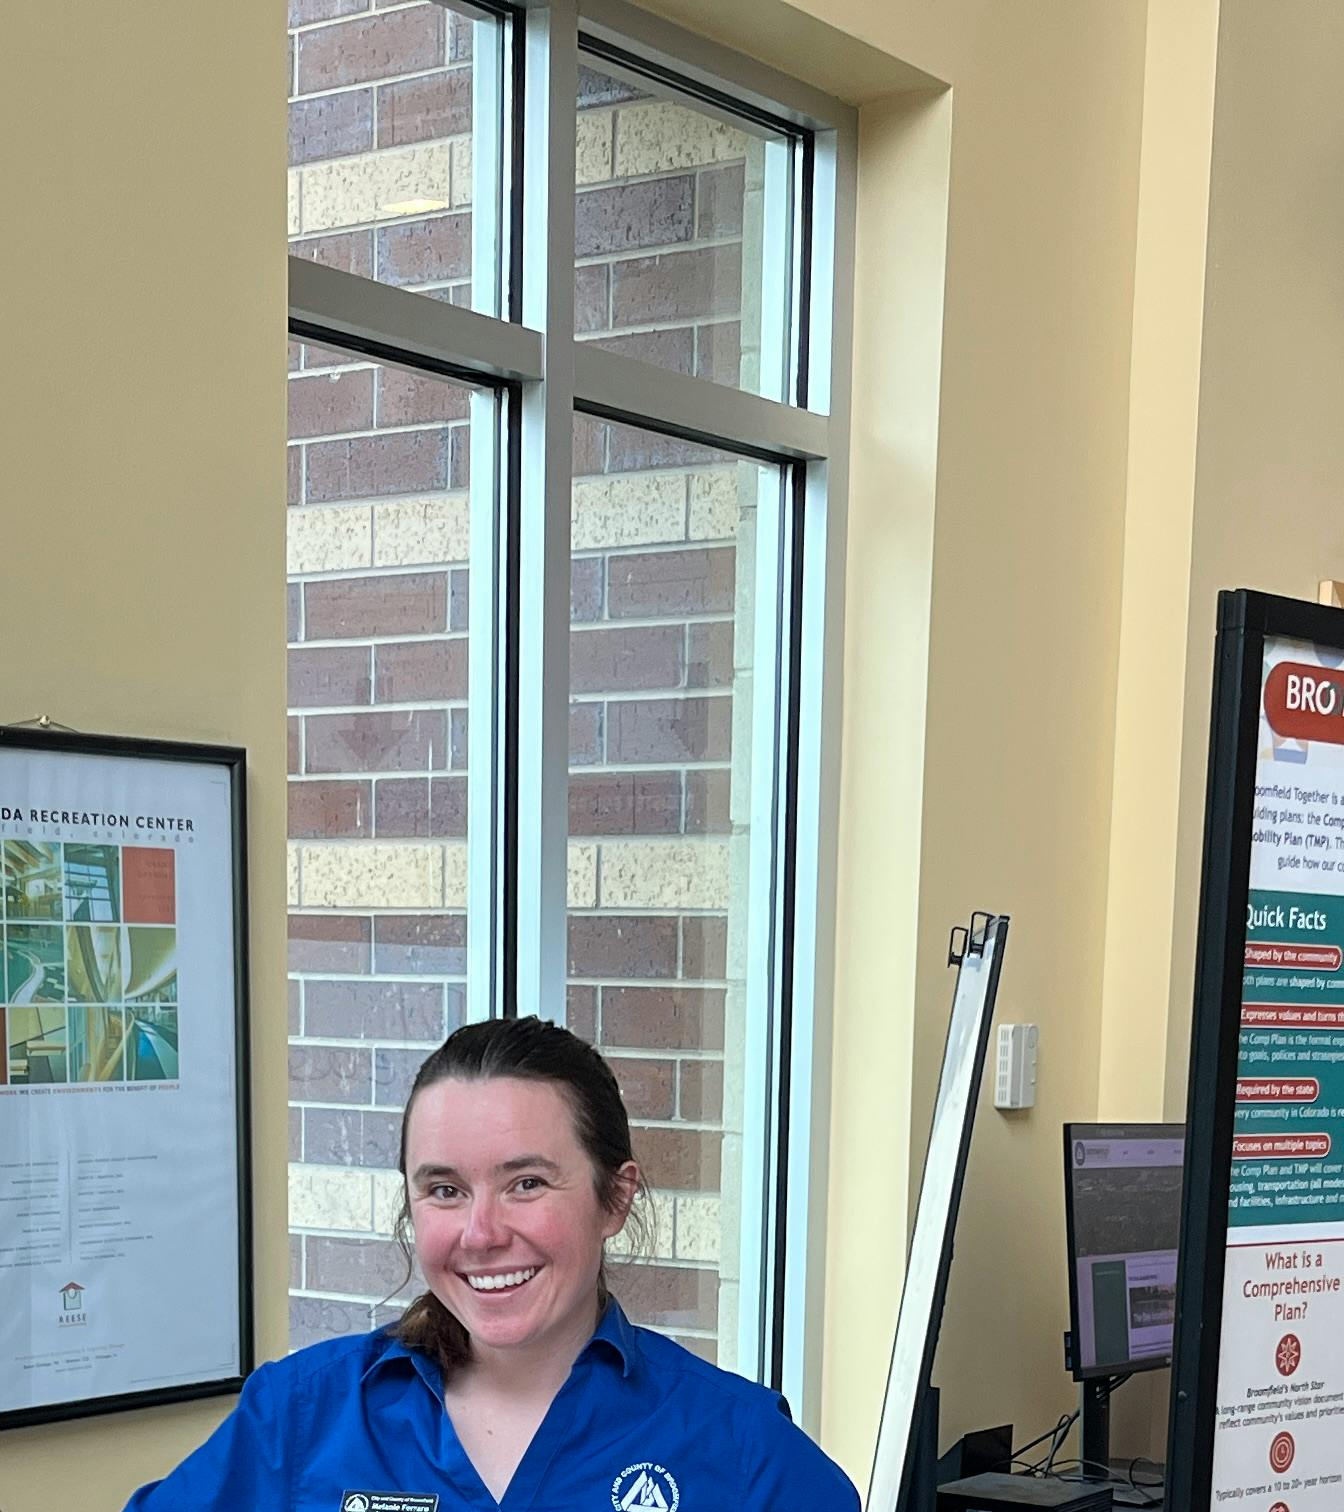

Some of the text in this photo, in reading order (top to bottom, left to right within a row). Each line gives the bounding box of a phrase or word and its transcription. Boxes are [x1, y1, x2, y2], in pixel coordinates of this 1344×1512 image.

[30, 809, 129, 827] RECREATION
[135, 816, 194, 831] CENTER
[1279, 811, 1304, 824] plans:
[1307, 813, 1321, 826] the
[1277, 856, 1301, 871] guide
[1302, 858, 1321, 870] how
[1321, 860, 1336, 871] our
[1288, 907, 1327, 930] Facts
[1265, 1250, 1323, 1270] What is a
[1243, 1275, 1341, 1300] Comprehensive
[1274, 1301, 1308, 1322] Plan?
